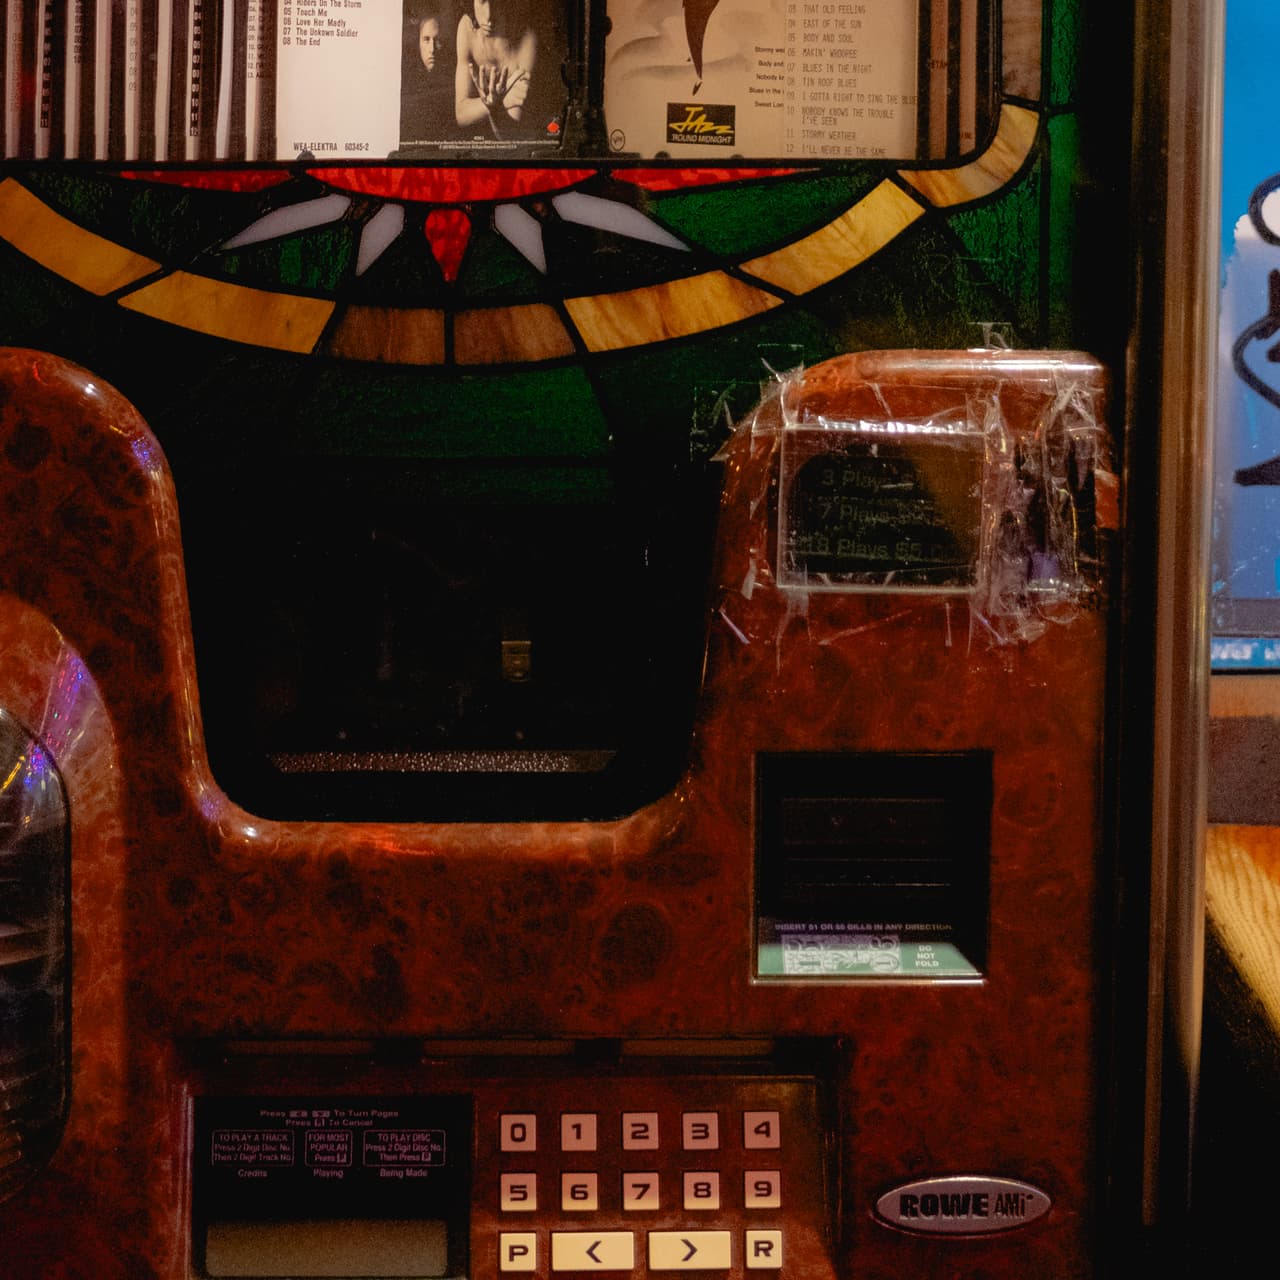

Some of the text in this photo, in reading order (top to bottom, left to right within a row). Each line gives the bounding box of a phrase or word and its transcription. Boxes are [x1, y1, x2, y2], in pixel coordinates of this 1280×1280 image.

[296, 8, 328, 17] Touch Me
[319, 0, 328, 7] On
[330, 0, 342, 8] The
[343, 0, 362, 9] Storm
[296, 17, 347, 28] Love Her Madly
[296, 27, 307, 36] The
[336, 28, 359, 38] Soldier
[295, 37, 321, 46] The End
[698, 134, 732, 145] MIDNIGHT
[774, 923, 806, 931] INSERT
[820, 923, 833, 931] OR
[847, 923, 873, 931] BILLS
[874, 923, 883, 931] IN
[886, 923, 903, 931] ANY
[905, 923, 953, 931] DIRECTION
[510, 1123, 527, 1143] 0
[571, 1123, 582, 1140] 1
[631, 1123, 650, 1140] 2
[691, 1123, 710, 1140] 3
[753, 1121, 771, 1138] 4
[310, 1143, 348, 1152] POPULAR
[237, 1168, 268, 1178] Credits
[313, 1168, 344, 1180] Playing
[380, 1168, 428, 1180] Being Made
[510, 1184, 528, 1202] 5
[570, 1183, 589, 1201] 6
[631, 1183, 651, 1200] 7
[693, 1181, 712, 1199] 8
[754, 1180, 773, 1198] 9
[899, 1193, 989, 1218] ROWE
[508, 1244, 529, 1262] P
[753, 1240, 774, 1258] R
